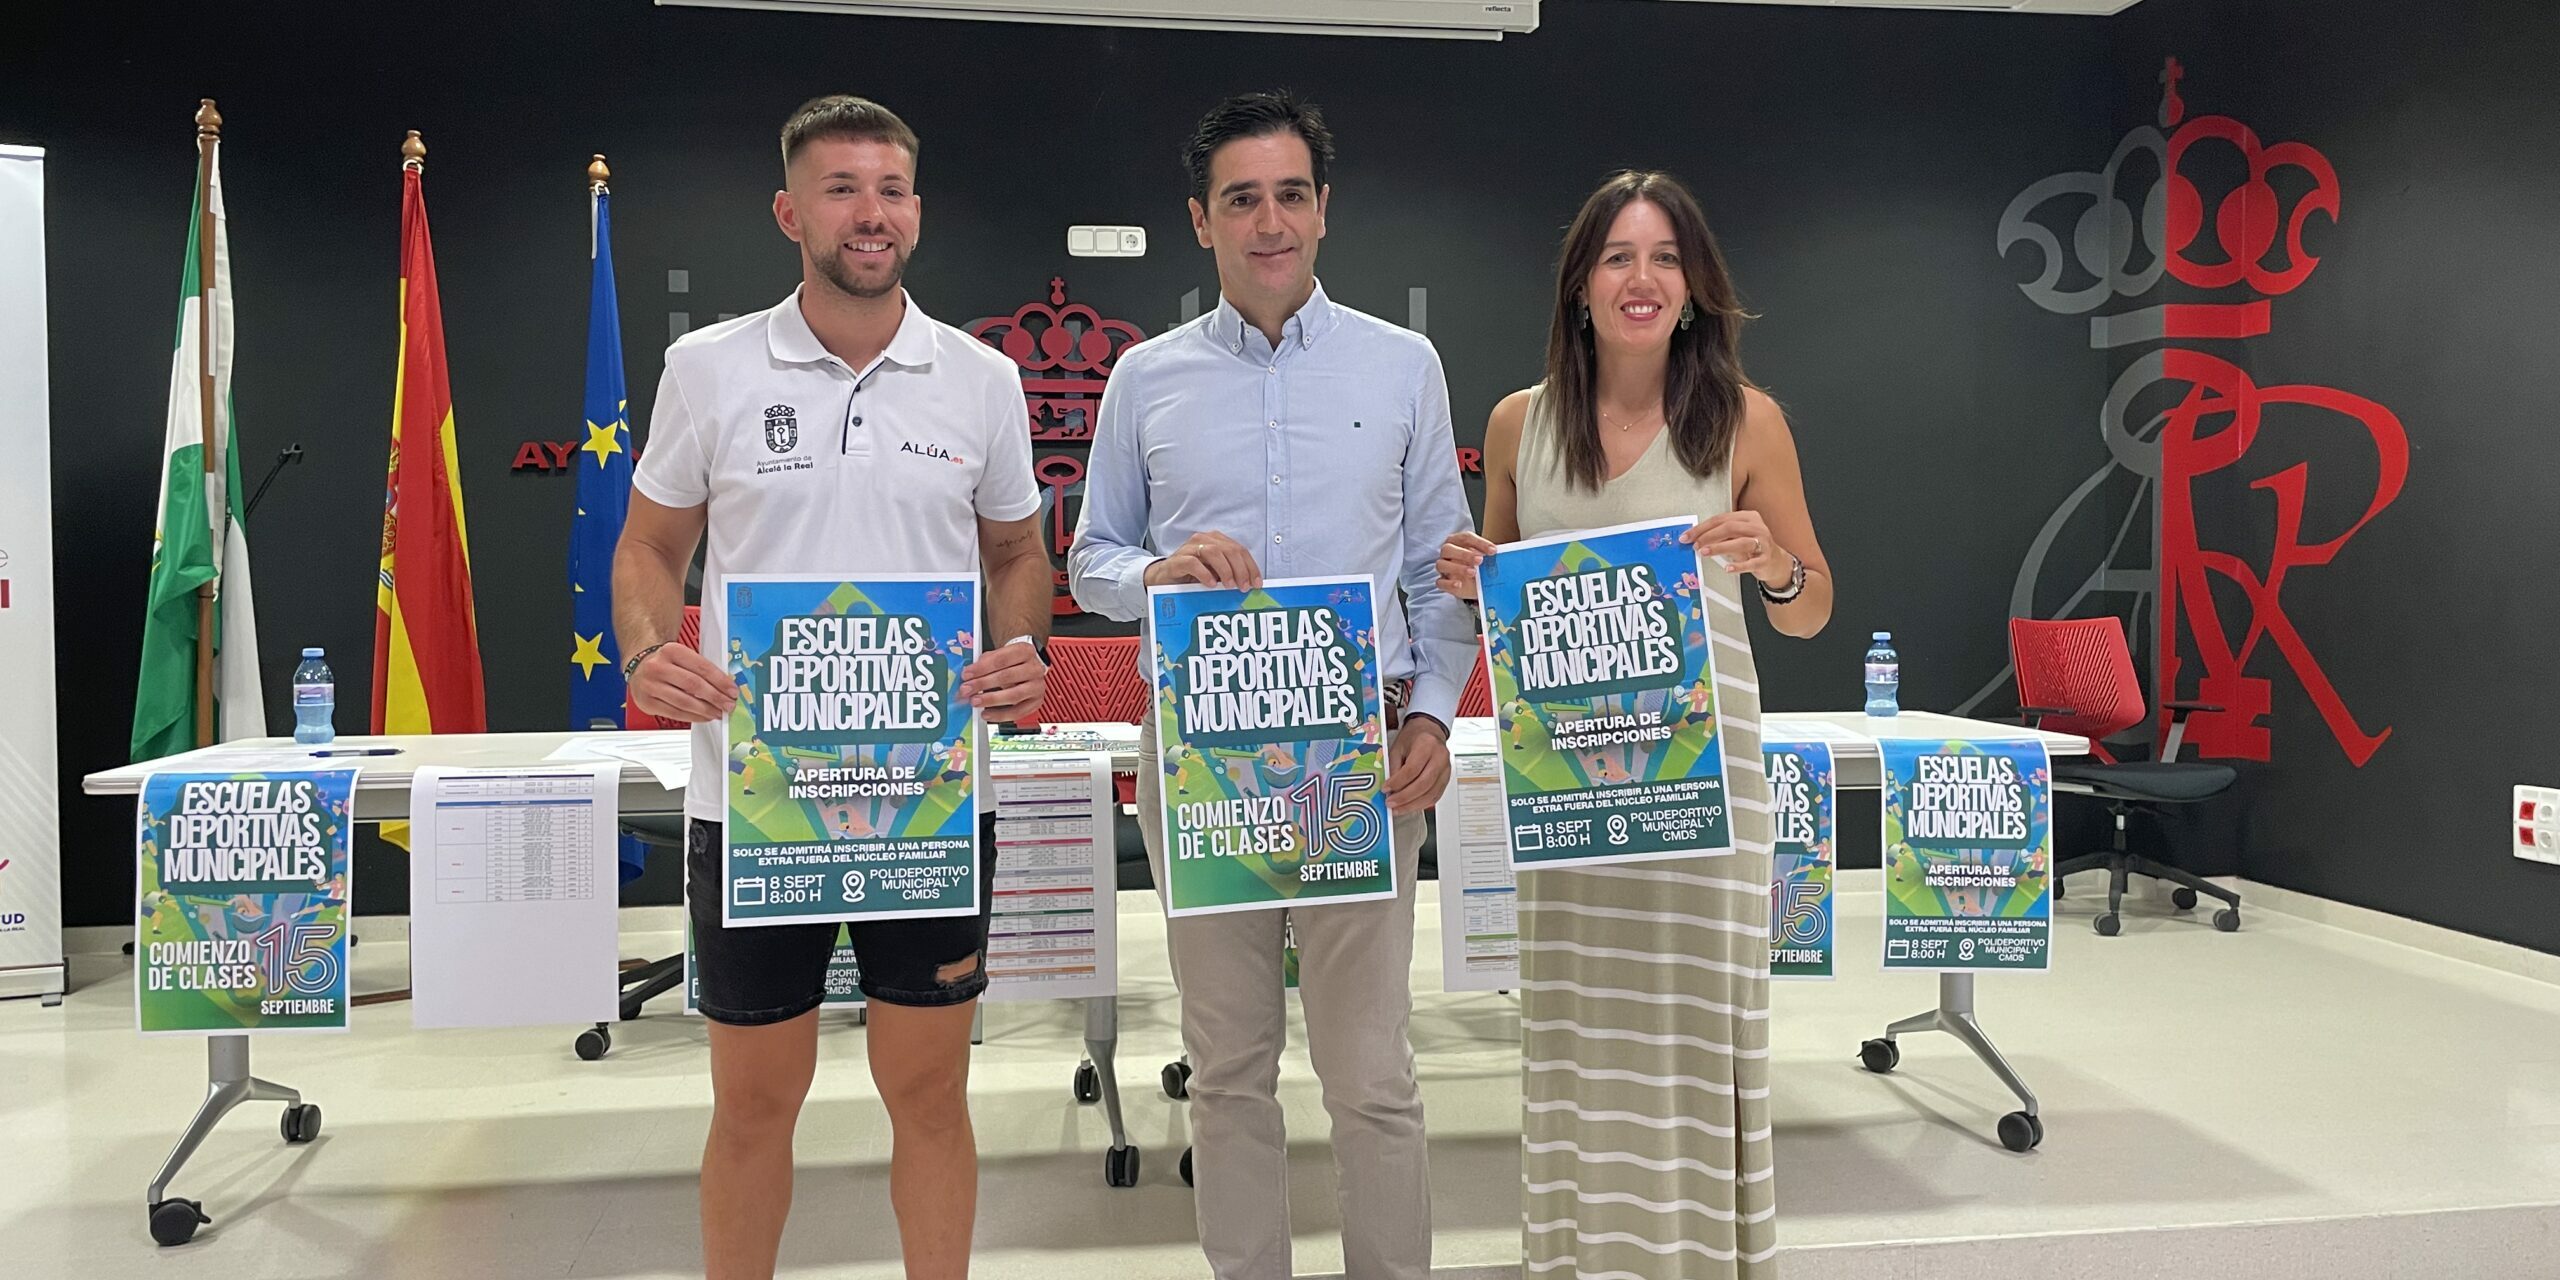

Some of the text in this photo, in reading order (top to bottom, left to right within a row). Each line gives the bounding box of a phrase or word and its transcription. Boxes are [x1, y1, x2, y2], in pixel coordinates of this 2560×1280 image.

[757, 457, 802, 468] Ayuntamiento
[794, 462, 813, 470] Real
[1525, 565, 1652, 618] ESCUELAS
[782, 617, 923, 656] ESCUELAS
[1197, 608, 1335, 655] ESCUELAS
[1520, 600, 1668, 655] DEPORTIVAS
[1188, 646, 1349, 695] DEPORTIVAS
[1519, 636, 1679, 691] MUNICIPALES
[769, 654, 935, 694] DEPORTIVAS
[763, 691, 941, 732] MUNICIPALES
[1183, 684, 1358, 735] MUNICIPALES
[1554, 711, 1662, 736] APERTURA DE
[1551, 726, 1672, 751] INSCRIPCIONES
[793, 766, 916, 783] APERTURA DE
[1918, 756, 2014, 785] ESCUELAS
[182, 781, 312, 815] ESCUELAS
[788, 782, 925, 799] INSCRIPCIONES
[1510, 780, 1720, 807] SOLO SE ADMITIRÁ INSCRIBIR A UNA PERSONA
[1912, 782, 2022, 812] DEPORTIVAS
[1532, 791, 1699, 814] EXTRA FUERA DEL NÚCLEO FAMILIAR
[1177, 795, 1286, 832] COMIENZO
[1290, 773, 1382, 858] 15
[1630, 805, 1722, 823] POLIDEPORTIVO
[170, 814, 321, 849] DEPORTIVAS
[1544, 819, 1592, 834] 8 SEPT
[1642, 817, 1714, 833] MUNICIPAL Y
[1908, 810, 2027, 840] MUNICIPALES
[1178, 825, 1295, 860] DE CLASES
[1546, 833, 1591, 848] 8:00 H
[1662, 829, 1698, 842] CMDS
[733, 840, 970, 858] SOLO SE ADMITIRÁ INSCRIBIR A UNA PERSONA
[164, 847, 326, 882] MUNICIPALES
[758, 851, 947, 866] EXTRA FUERA DEL NÚCLEO FAMILIAR
[870, 865, 969, 880] POLIDEPORTIVO
[1300, 859, 1380, 883] SEPTIEMBRE
[1928, 865, 2010, 876] APERTURA DE
[770, 874, 825, 889] 8 SEPT
[882, 877, 960, 890] MUNICIPAL Y
[1925, 876, 2016, 887] INSCRIPCIONES
[770, 889, 822, 903] 8:00 H
[902, 888, 940, 900] CMDS
[0, 913, 25, 925] UD
[1955, 919, 1990, 927] INSCRIBIR
[1912, 939, 1949, 949] 8 SEPT
[1978, 938, 2045, 947] POLIDEPORTIVO
[1985, 946, 2031, 954] MUNICIPAL
[150, 940, 250, 966] COMIENZO
[256, 923, 338, 995] 15
[1770, 949, 1823, 963] EPTIEMBRE
[1911, 950, 1945, 959] 8:00 H
[1998, 954, 2024, 962] CMDS
[148, 965, 257, 991] DE CLASES
[260, 999, 335, 1015] SEPTIEMBRE
